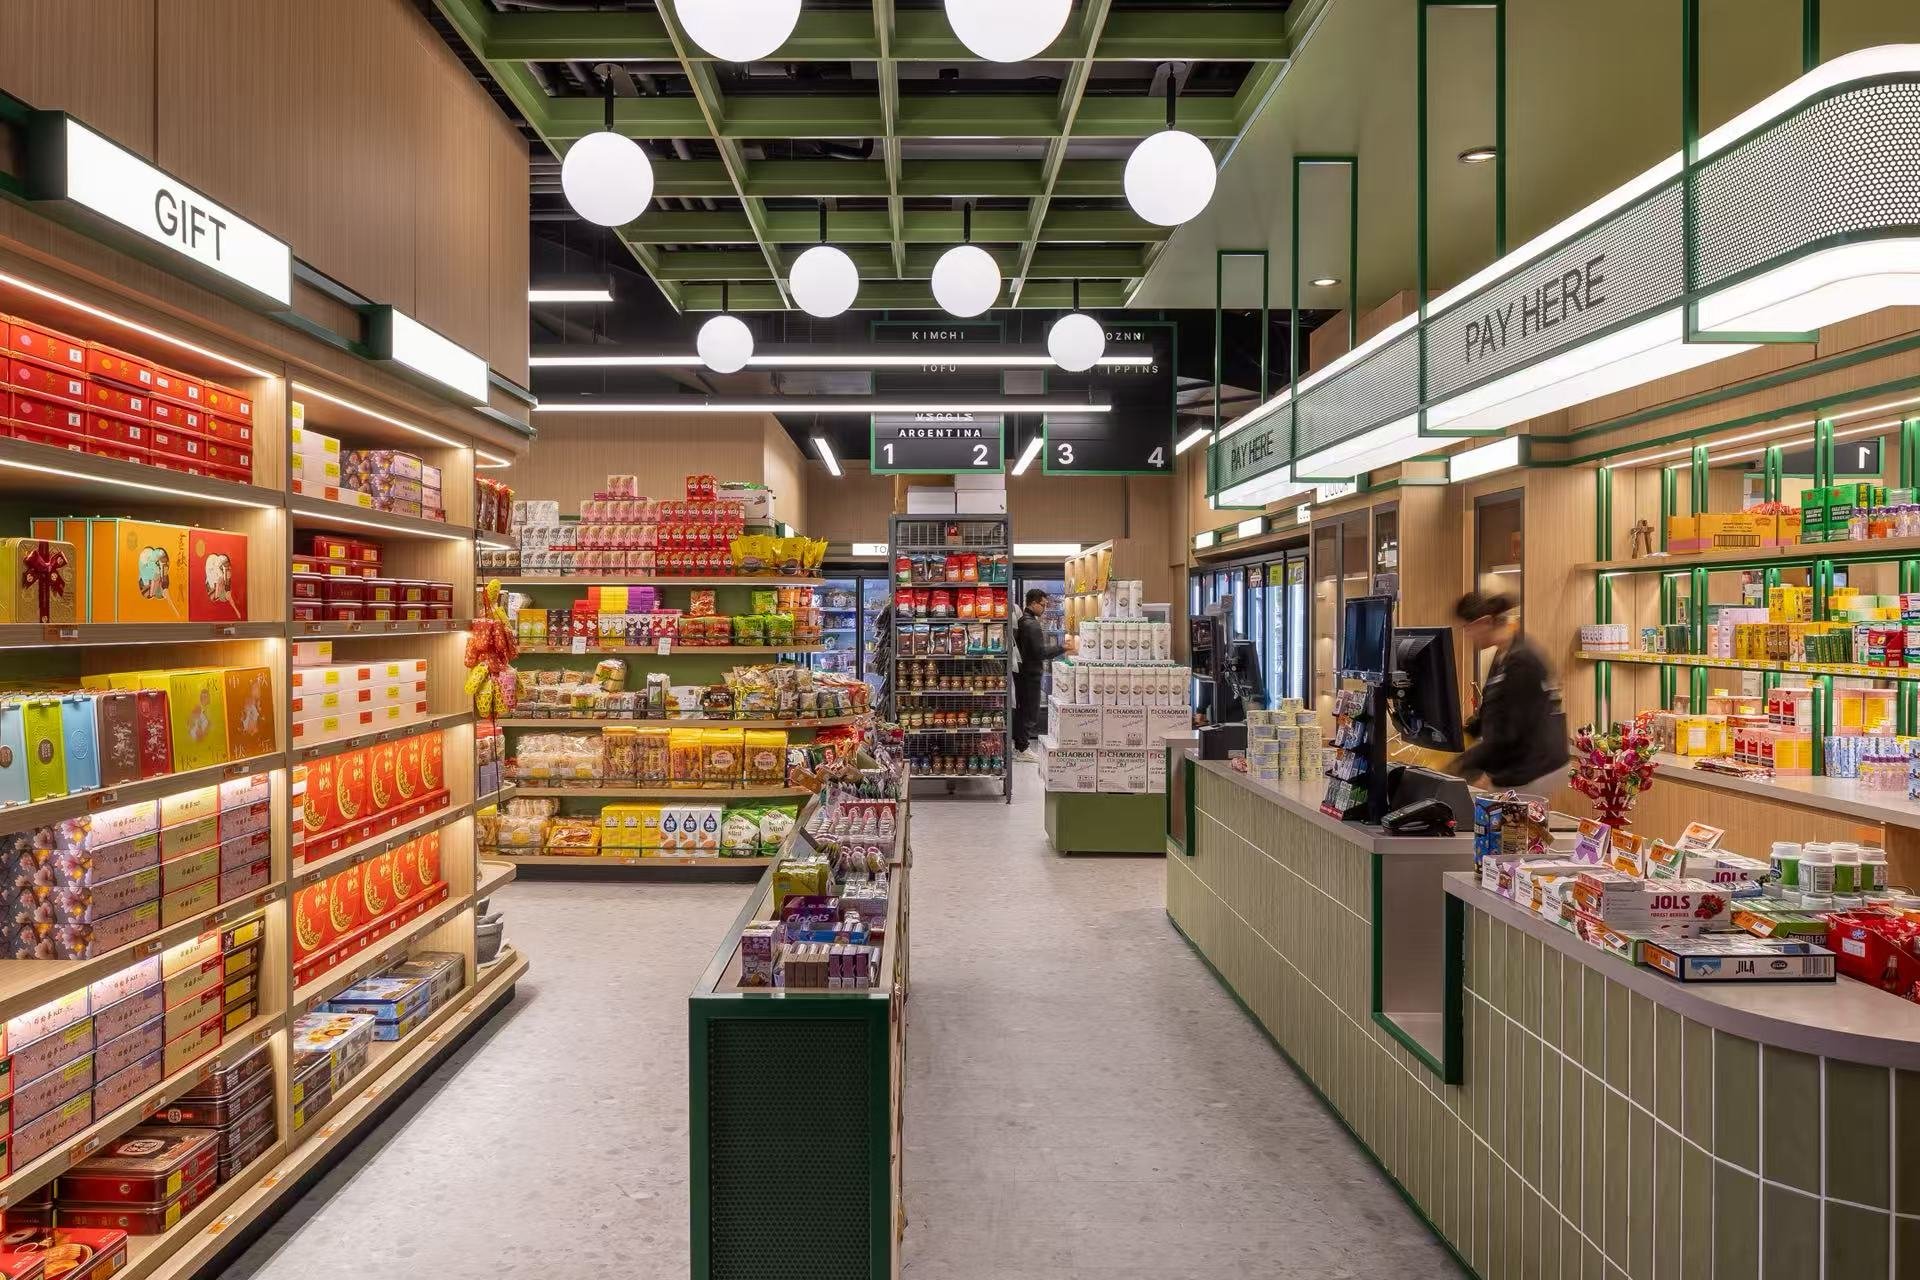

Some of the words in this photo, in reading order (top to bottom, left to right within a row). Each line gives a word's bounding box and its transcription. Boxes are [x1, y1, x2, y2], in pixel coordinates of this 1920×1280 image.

[154, 188, 227, 261] GIFT
[1465, 302, 1514, 363] PAY
[1522, 253, 1605, 337] HERE
[911, 330, 965, 341] KIMCHI
[922, 363, 957, 373] TOFU
[898, 428, 981, 438] ARGENTINA
[882, 442, 895, 465] 1
[972, 444, 989, 466] 2
[1057, 443, 1075, 466] 3
[1147, 446, 1165, 469] 4
[1230, 441, 1249, 473] PAY
[1249, 428, 1274, 465] HERE
[872, 545, 888, 554] TO
[1650, 894, 1691, 910] JOLS
[1735, 960, 1755, 975] JILA
